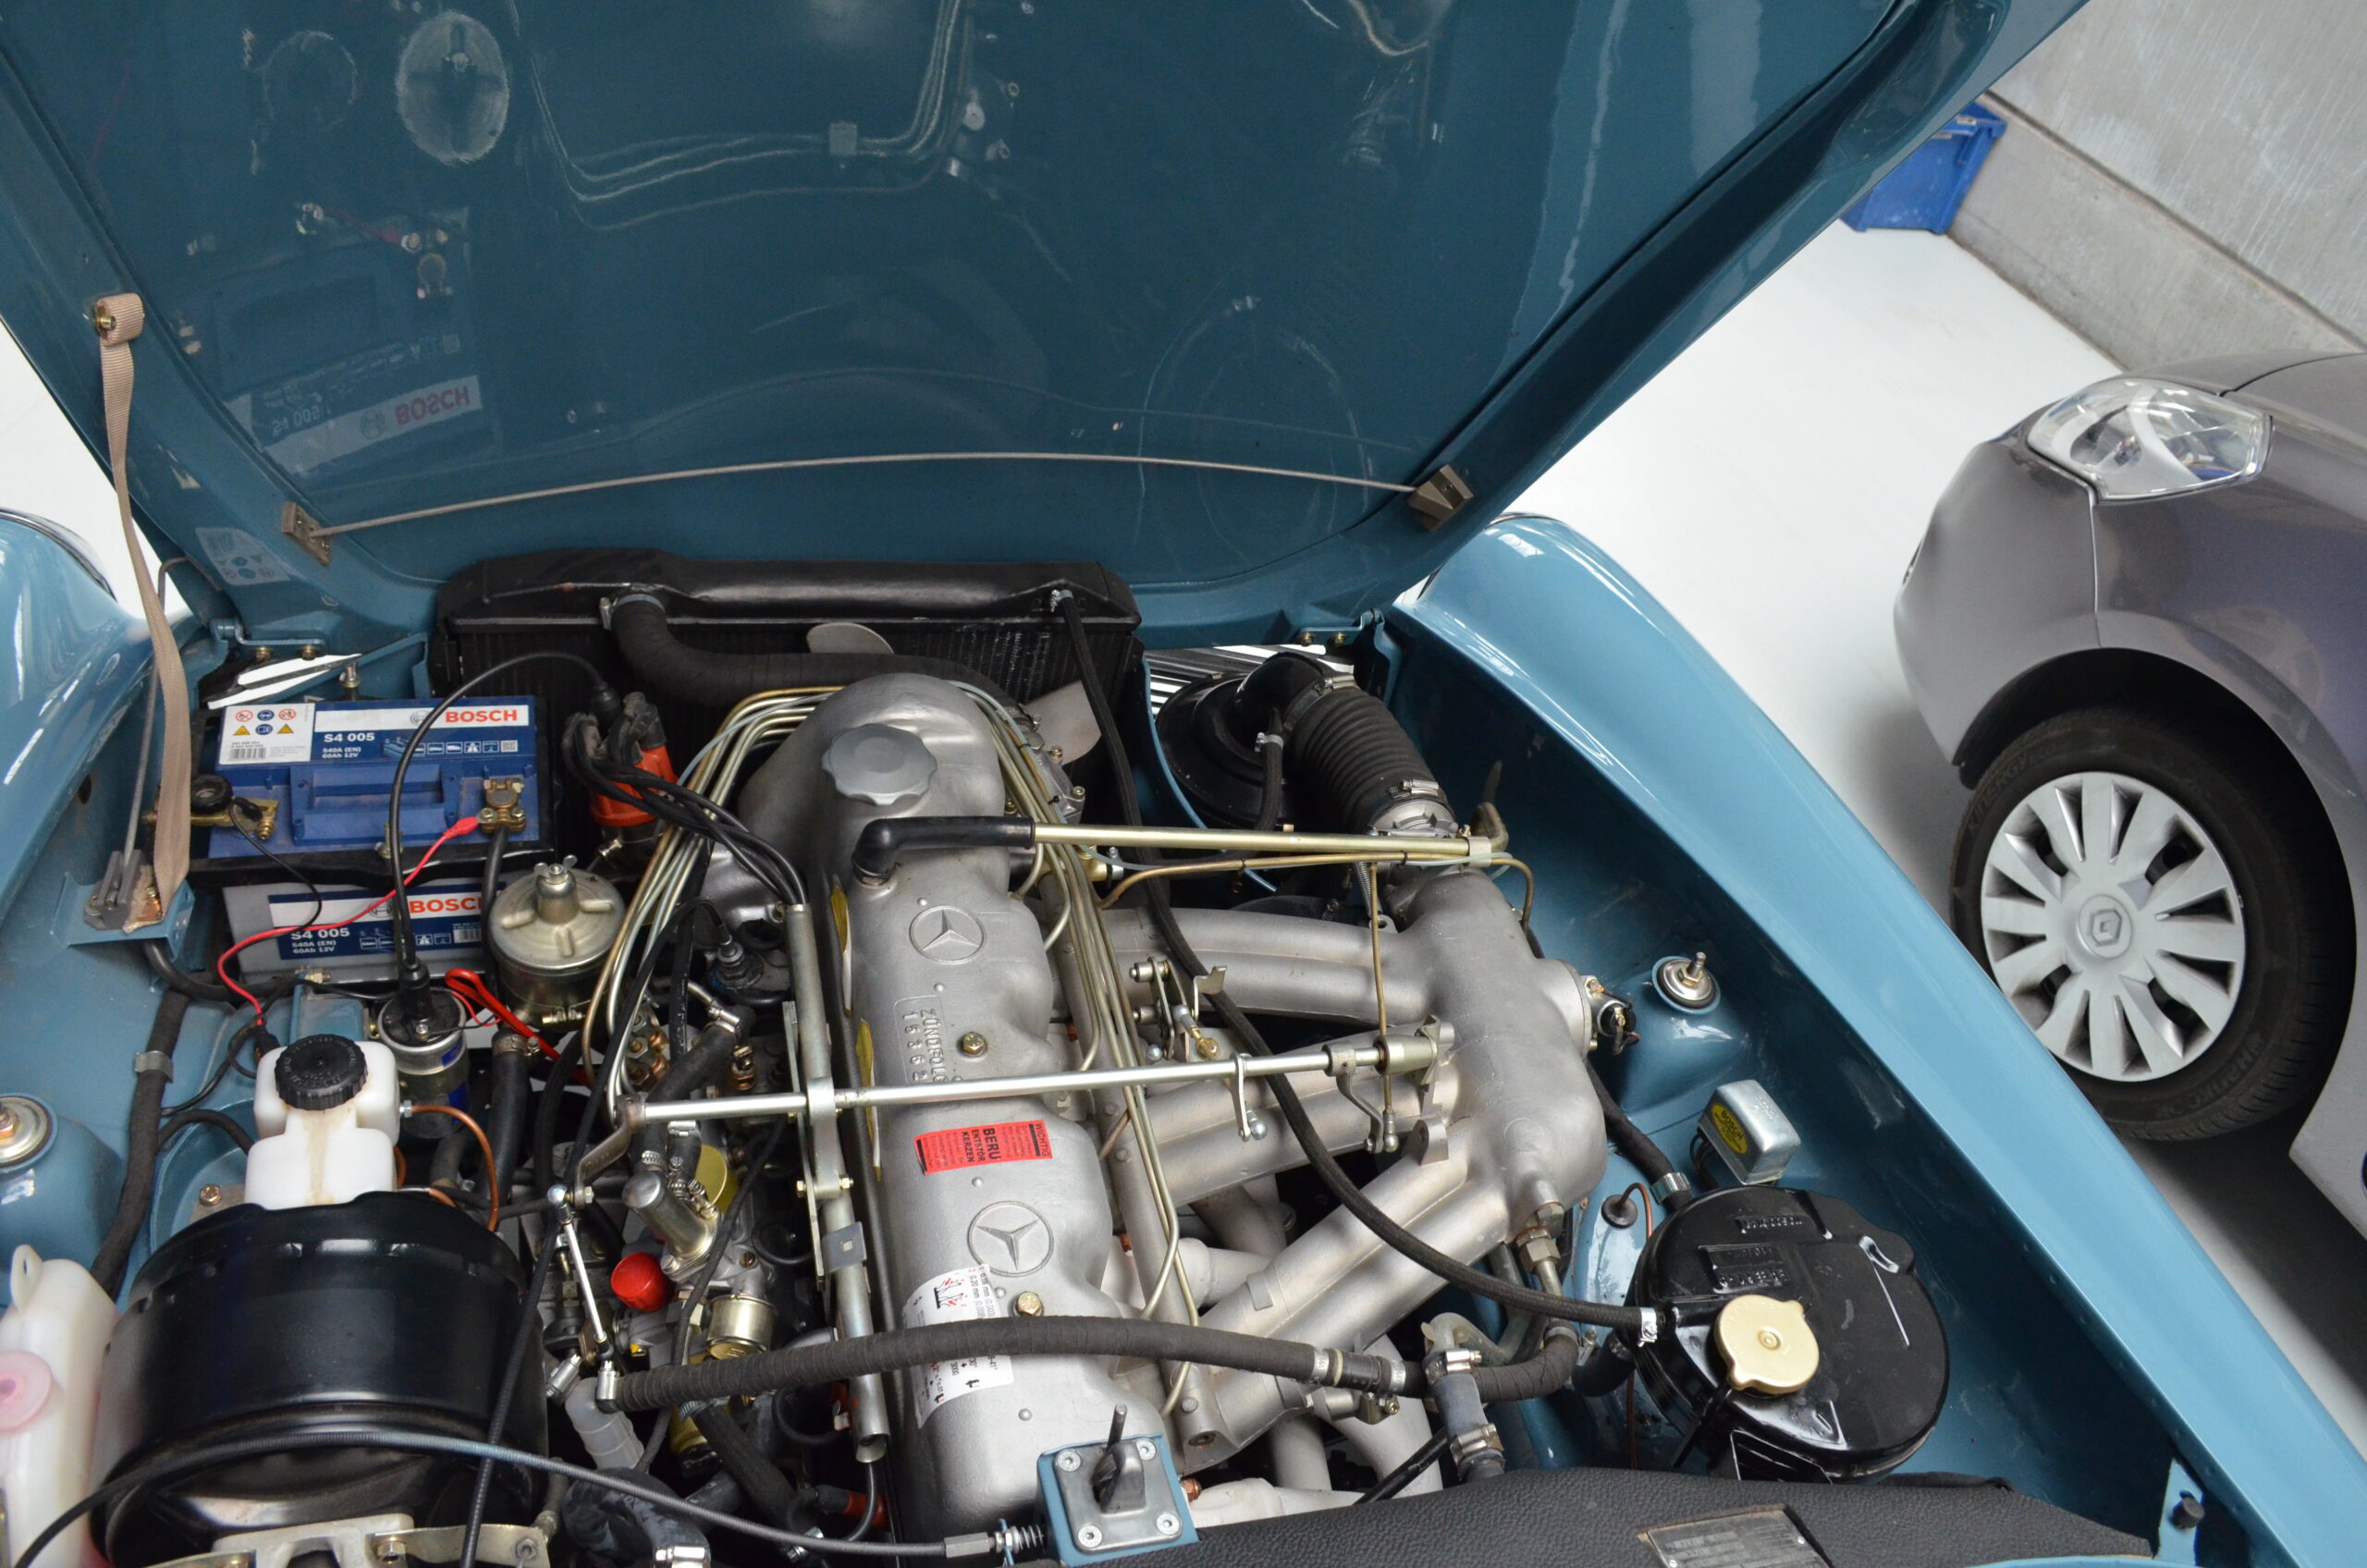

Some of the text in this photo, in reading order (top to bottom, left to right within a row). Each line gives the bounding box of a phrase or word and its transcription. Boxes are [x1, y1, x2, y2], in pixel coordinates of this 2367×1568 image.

[445, 709, 518, 723] BOSCH
[324, 732, 375, 742] S4 005
[410, 897, 482, 913] BOSC
[291, 927, 350, 940] S4 005
[317, 939, 337, 948] (EN)
[920, 1008, 949, 1083] ZÜNDFOLG
[1035, 1123, 1049, 1157] WICHTIG
[1721, 1110, 1744, 1140] BOSCH
[961, 1131, 975, 1163] KERZEN
[971, 1129, 986, 1162] ENTSTÖR
[982, 1127, 1002, 1160] BERU
